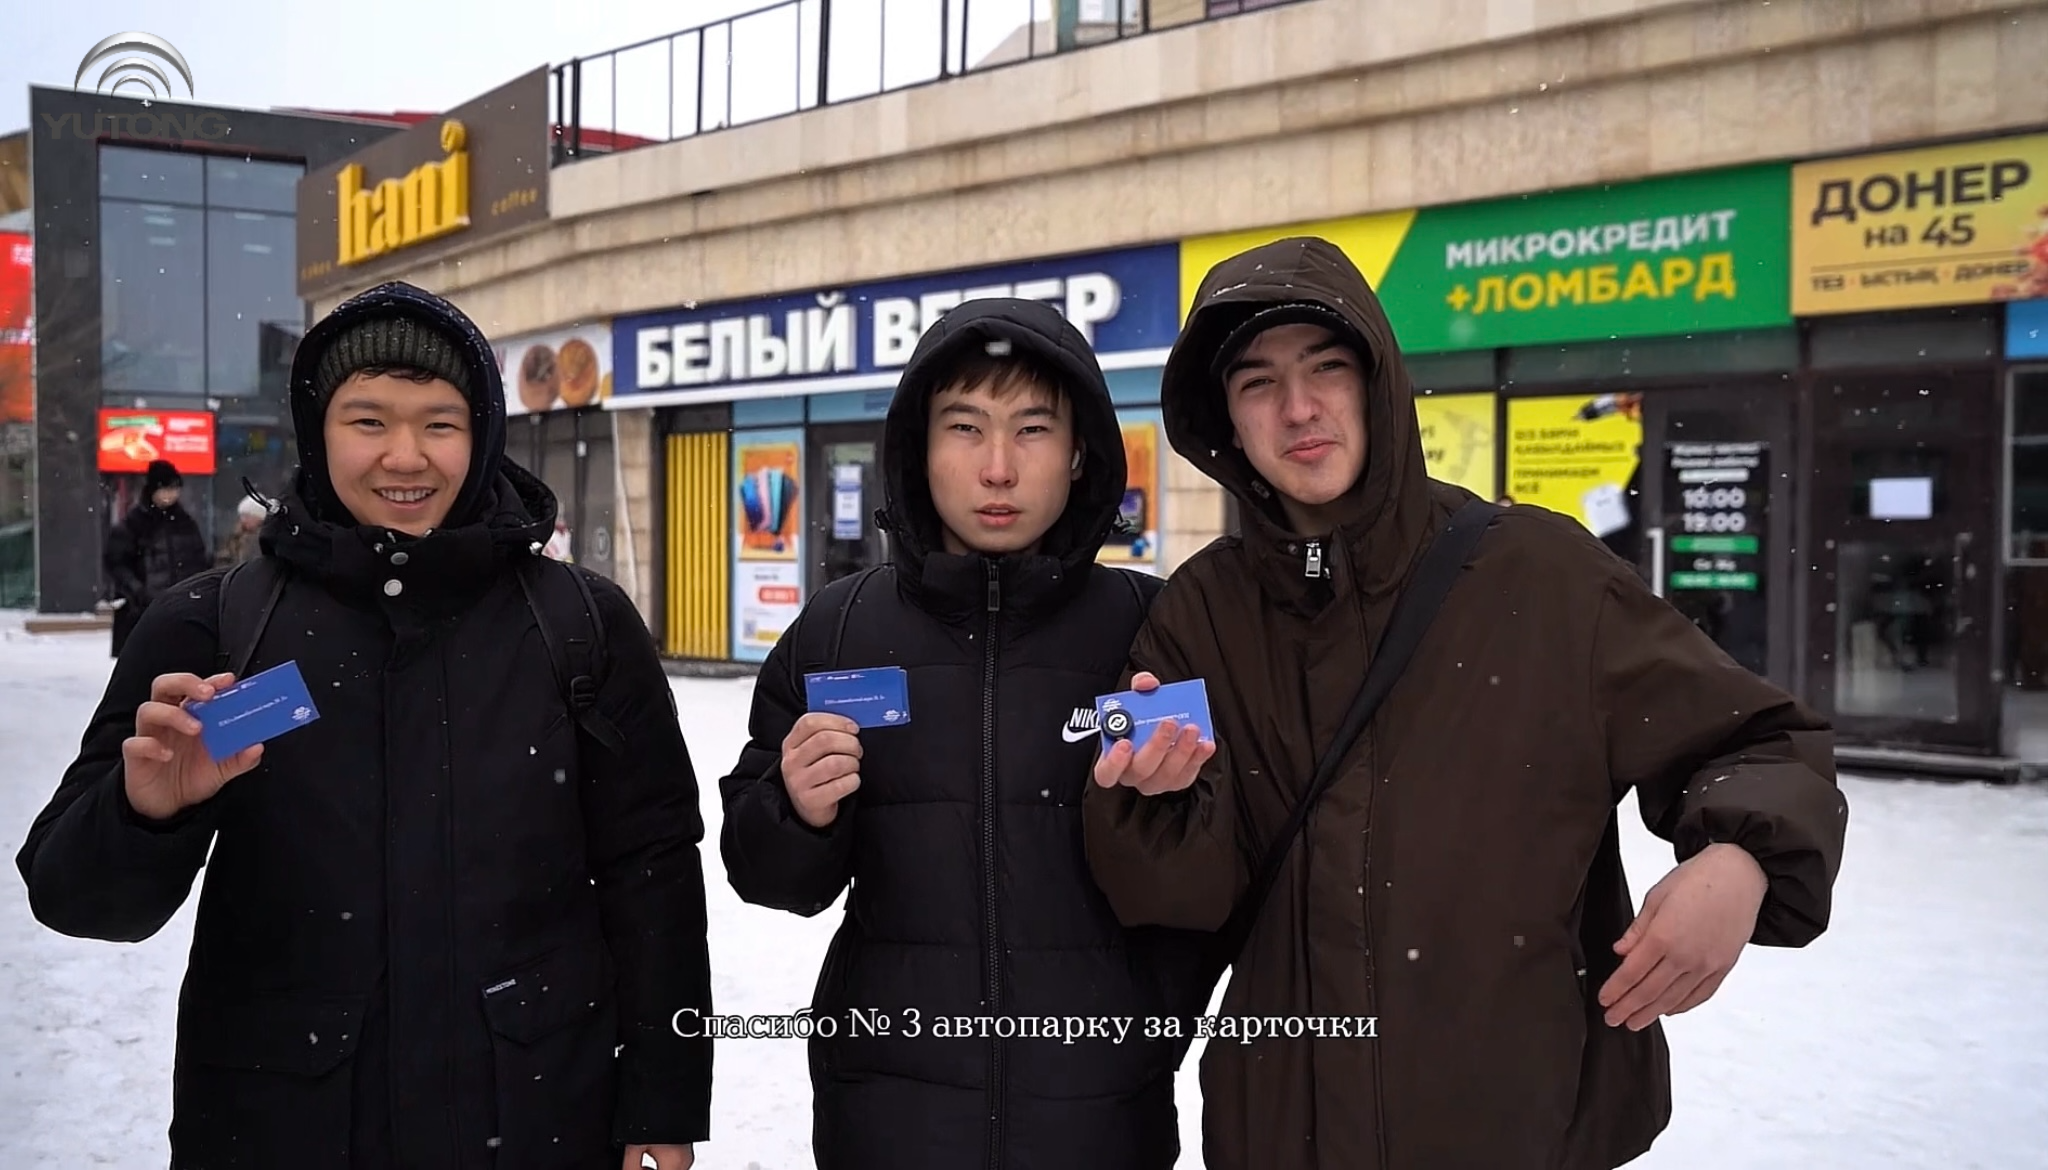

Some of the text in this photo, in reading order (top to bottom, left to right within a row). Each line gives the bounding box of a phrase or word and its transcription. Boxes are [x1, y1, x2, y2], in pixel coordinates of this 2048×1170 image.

[337, 118, 471, 266] hani
[1811, 159, 2031, 227] ДОНЕР
[1446, 209, 1737, 269] МИКРОКРЕДИТ
[1864, 213, 1977, 249] на 45
[1446, 252, 1737, 315] +ЛОМБАРД
[636, 272, 1121, 390] БЕЛЫЙ ВЕР
[1683, 487, 1746, 509] 10:00
[1069, 707, 1100, 729] NIK
